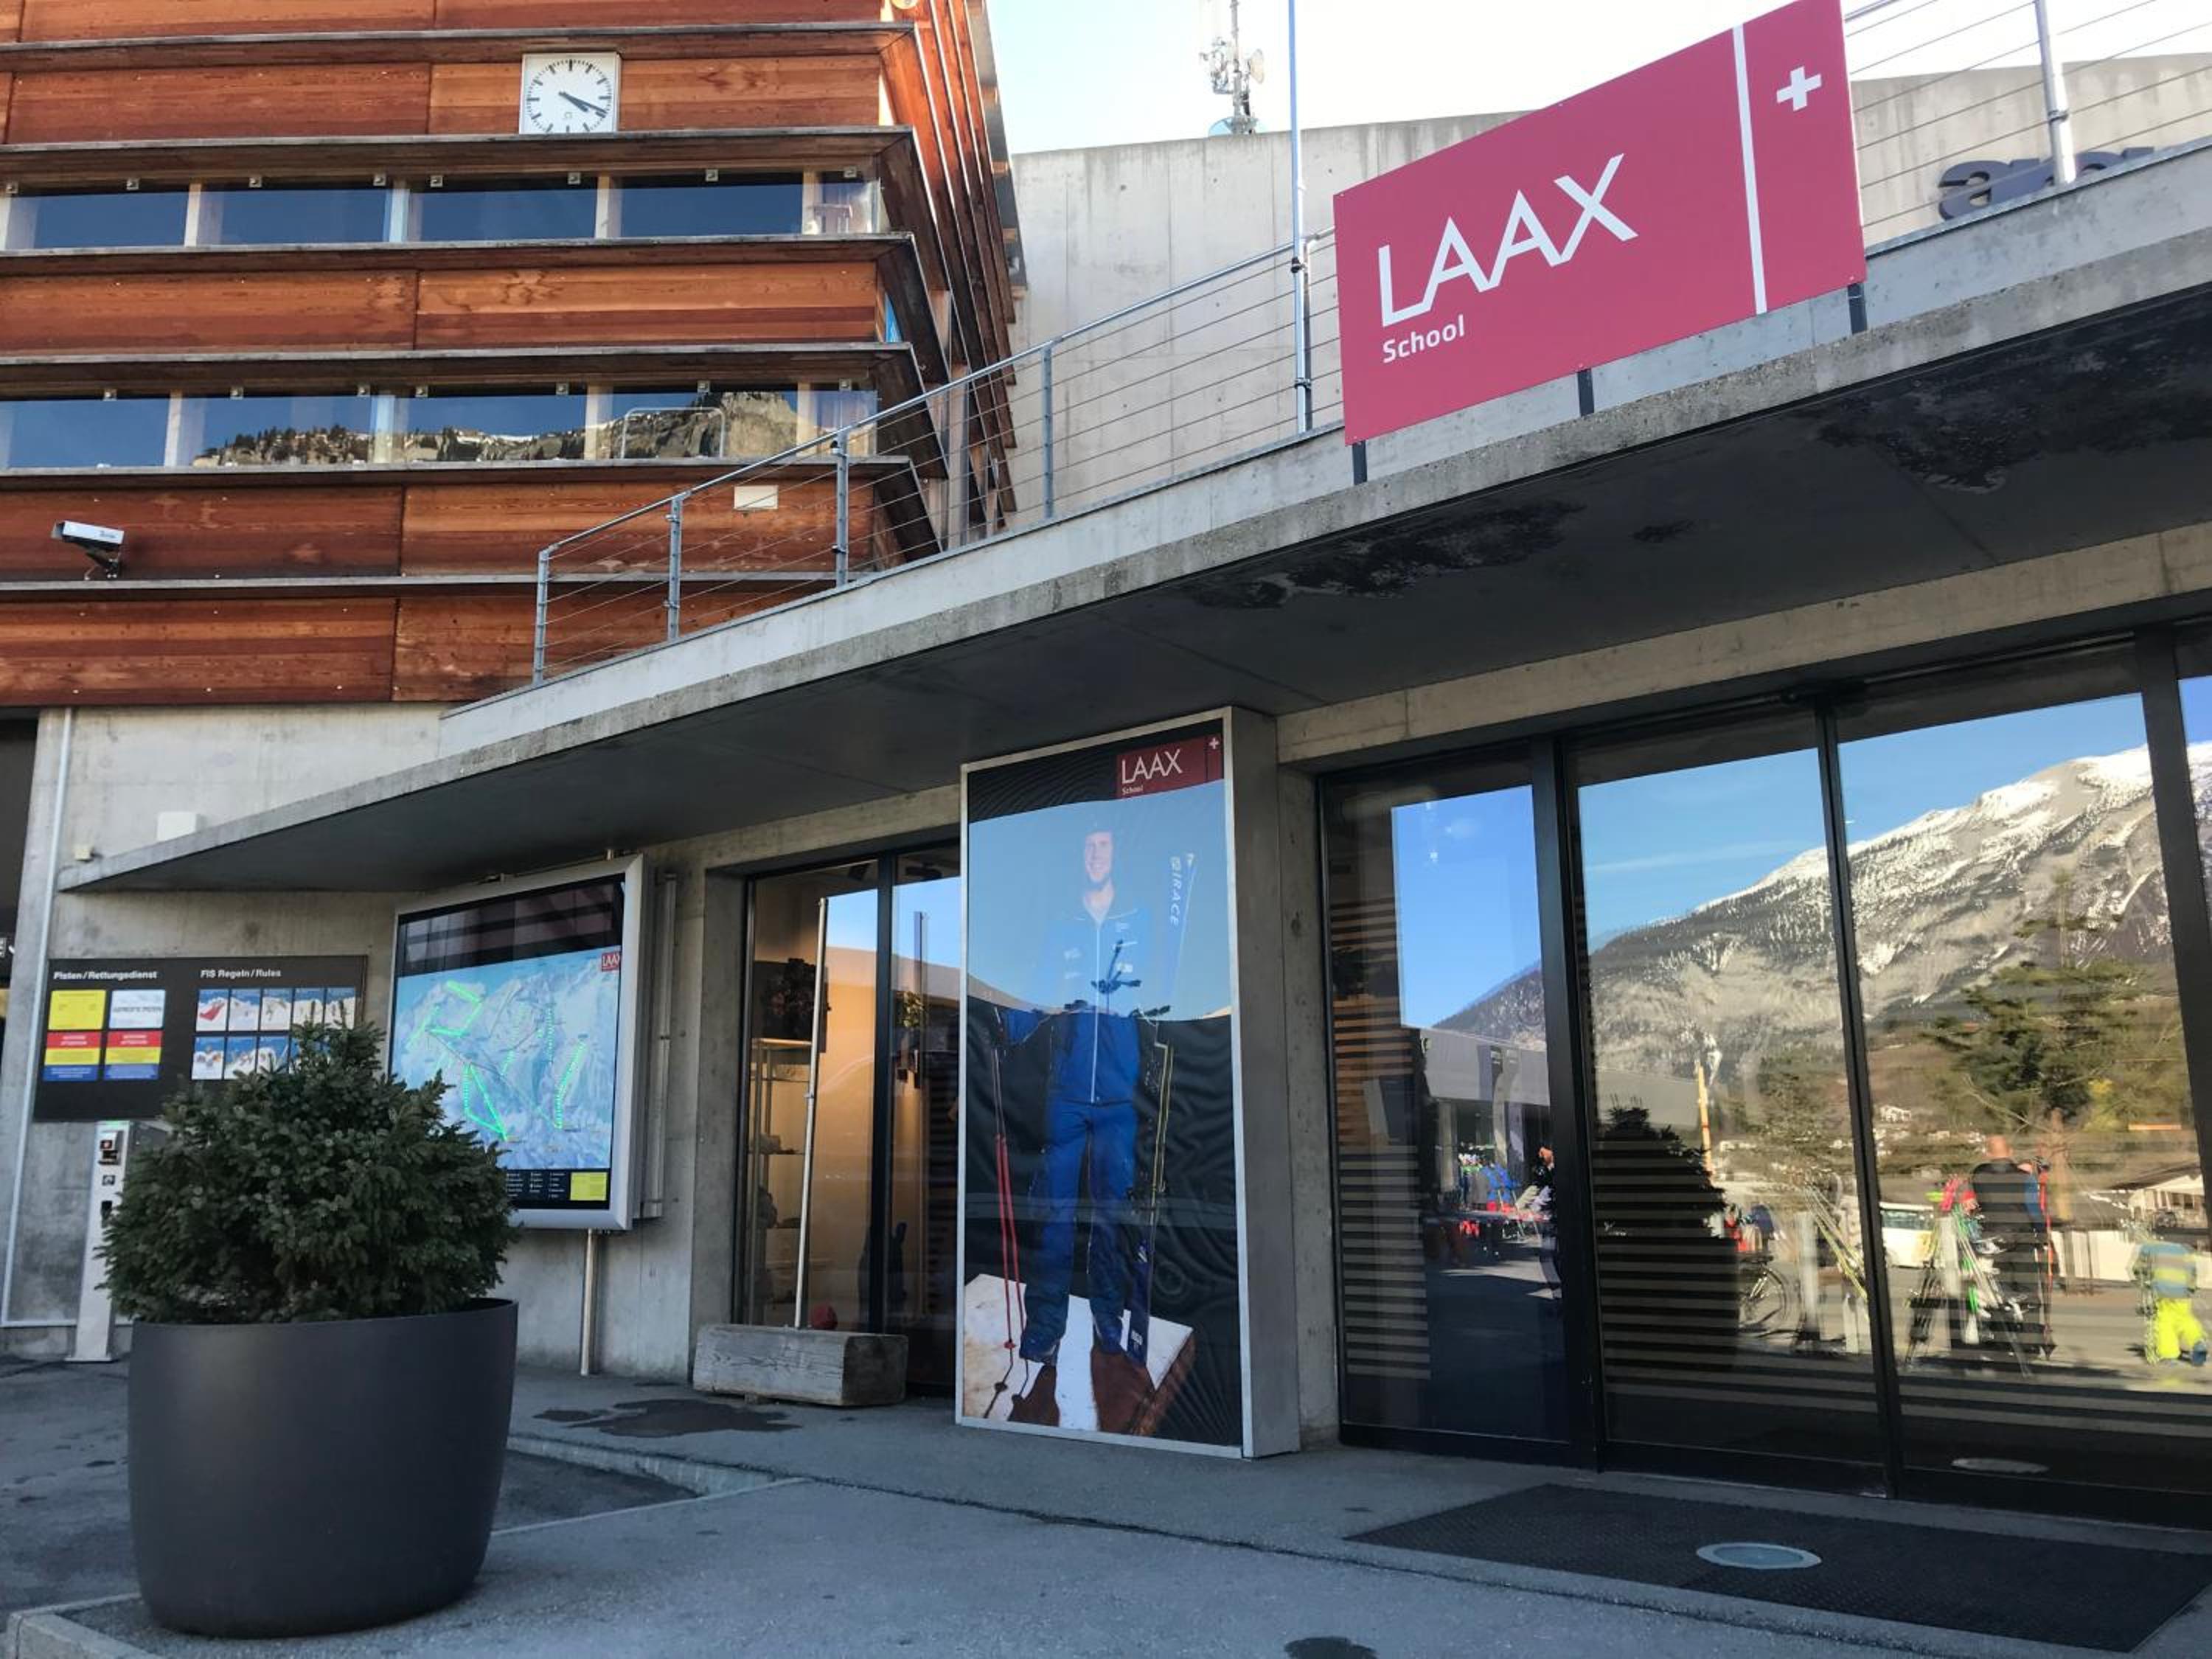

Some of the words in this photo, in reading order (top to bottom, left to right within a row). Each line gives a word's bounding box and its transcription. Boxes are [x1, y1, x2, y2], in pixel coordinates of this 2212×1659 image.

[1378, 153, 1639, 327] LAAX
[1382, 314, 1465, 364] School
[1121, 748, 1183, 784] LAAX
[1121, 785, 1144, 796] School
